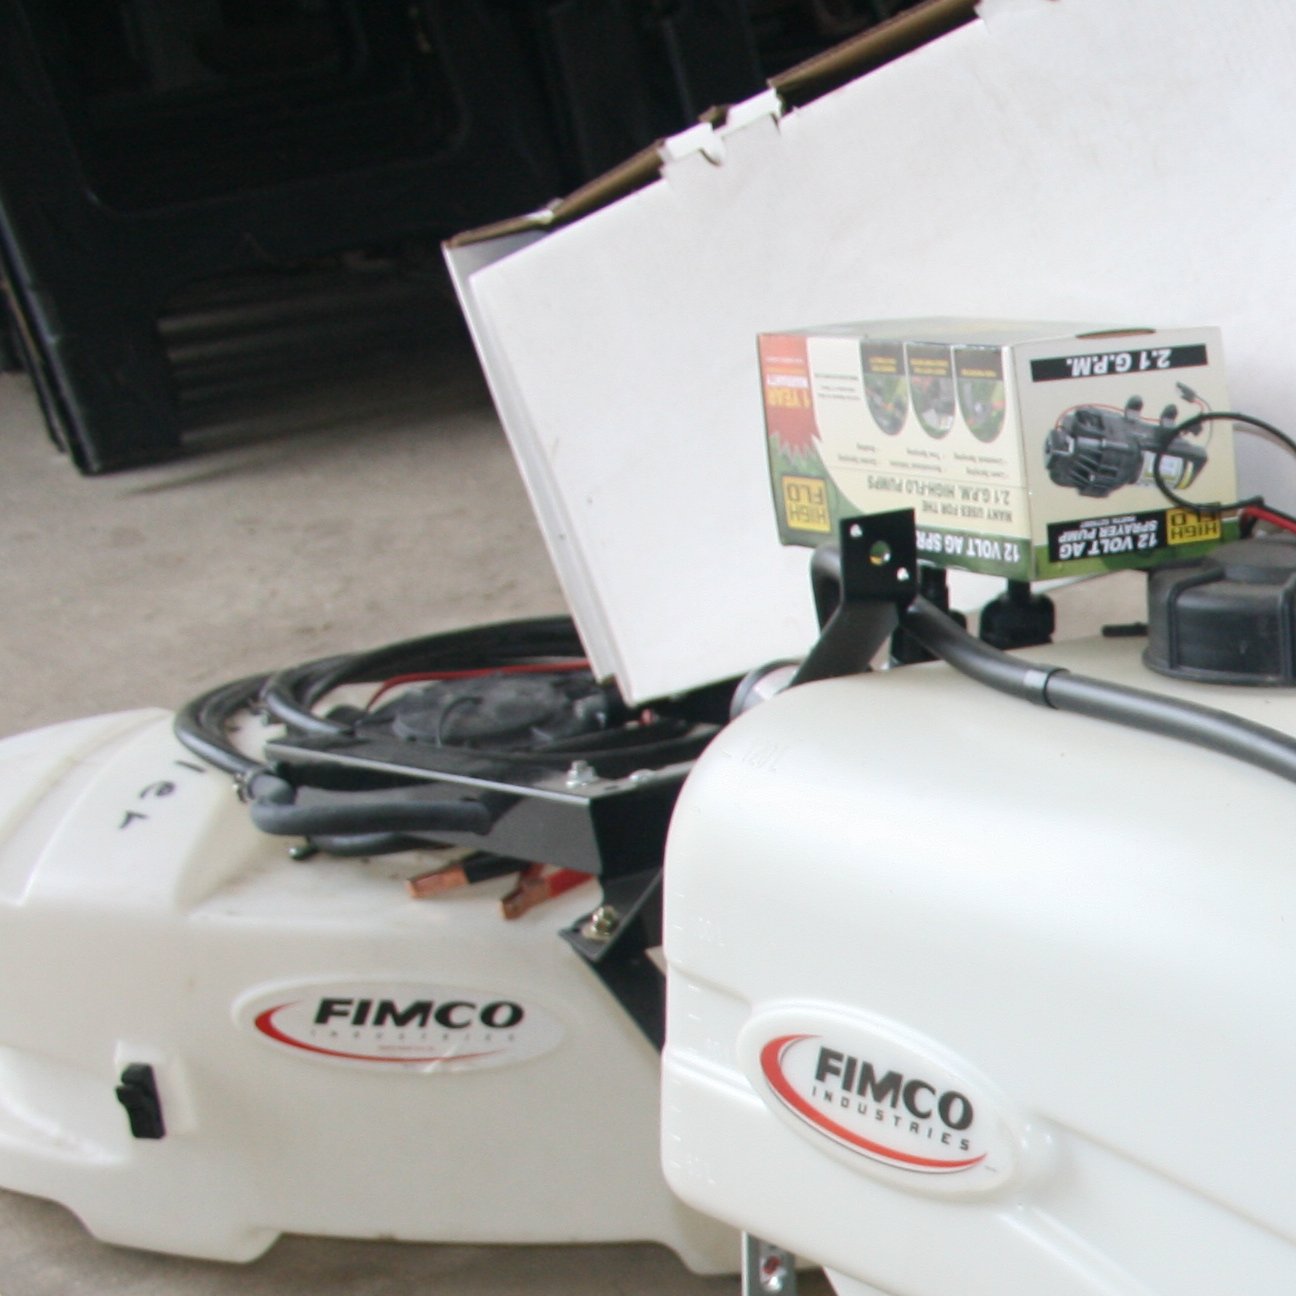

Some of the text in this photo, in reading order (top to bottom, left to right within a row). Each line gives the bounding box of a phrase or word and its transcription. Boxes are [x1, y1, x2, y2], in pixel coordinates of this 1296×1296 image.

[1066, 349, 1172, 377] 2.1 G.P.M.
[787, 483, 825, 506] FLO
[790, 503, 827, 525] HIGH
[1058, 526, 1098, 543] PUMP
[1100, 520, 1158, 538] SPRAYER
[1170, 522, 1219, 540] HIGH
[945, 535, 963, 555] AG
[965, 538, 1000, 560] VOLT
[1004, 542, 1021, 562] 12
[1059, 533, 1158, 559] 12 VOLT AG
[314, 997, 524, 1029] FIMCO
[815, 1046, 974, 1131] FIMCO
[811, 1086, 970, 1152] INDUSTRIES
